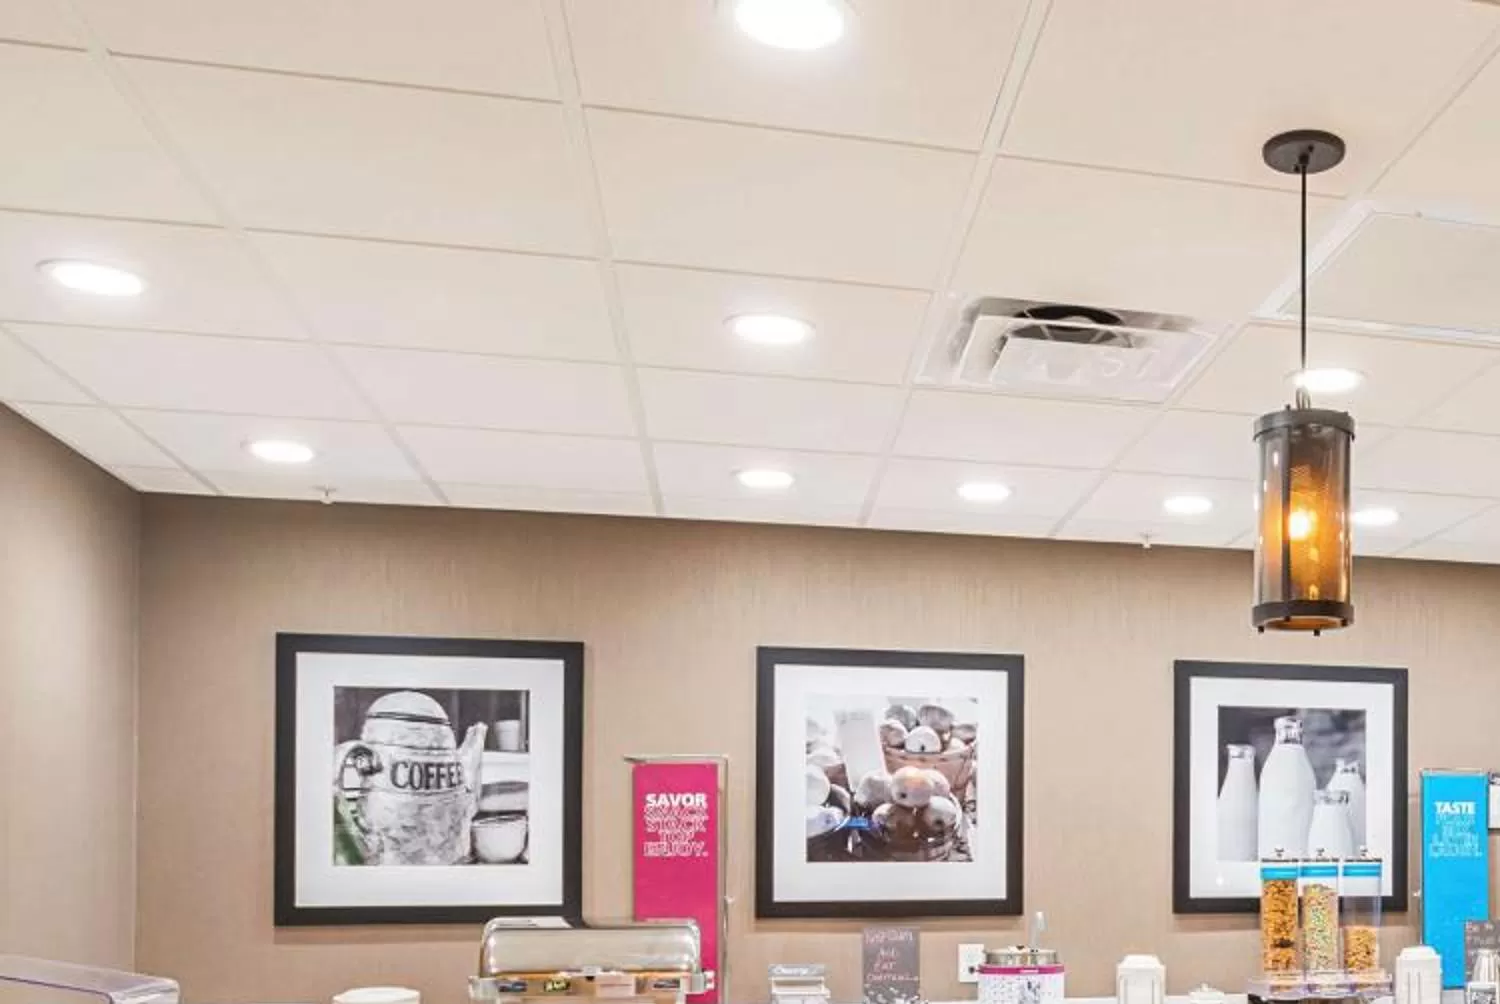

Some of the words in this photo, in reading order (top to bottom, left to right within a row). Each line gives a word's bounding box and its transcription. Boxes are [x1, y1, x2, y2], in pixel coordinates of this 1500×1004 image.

[389, 761, 464, 790] COFFEE
[645, 793, 708, 807] SAVOR
[1435, 801, 1475, 814] TASTE
